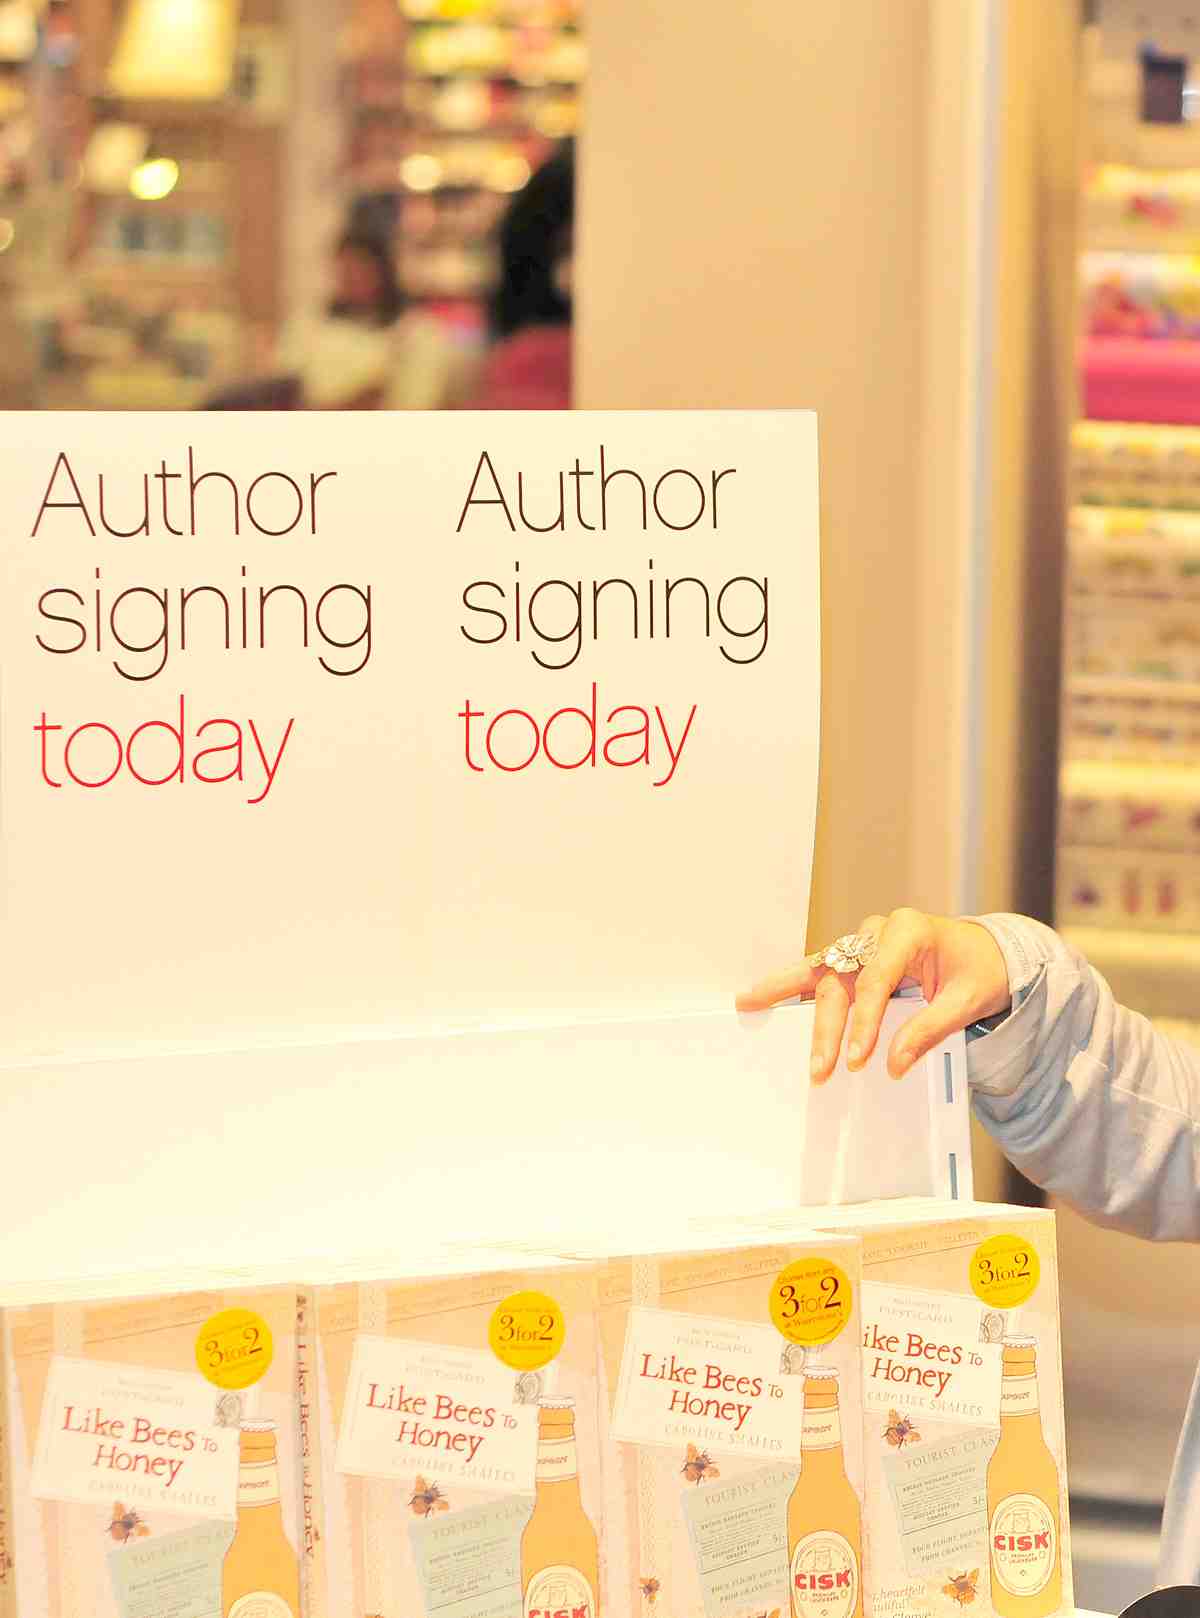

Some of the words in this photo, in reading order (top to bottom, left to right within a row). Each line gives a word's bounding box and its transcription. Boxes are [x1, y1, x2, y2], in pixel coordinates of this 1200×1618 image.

[31, 445, 338, 538] Author
[456, 444, 738, 533] Author
[35, 566, 373, 682] signing
[460, 559, 770, 670] signing
[33, 694, 295, 804] today
[458, 682, 698, 786] today
[863, 1324, 900, 1353] ike
[904, 1333, 963, 1365] Bees
[968, 1351, 984, 1367] To
[640, 1353, 697, 1385] Like
[703, 1364, 763, 1398] Bees
[767, 1383, 784, 1399] To
[871, 1356, 953, 1399] Honey
[61, 1405, 126, 1439] Like
[130, 1416, 196, 1452] Bees
[201, 1437, 218, 1454] To
[366, 1382, 427, 1416] Like
[432, 1394, 497, 1429] Bees
[500, 1414, 518, 1430] To
[668, 1389, 753, 1432] Honey
[395, 1420, 486, 1463] Honey
[92, 1444, 184, 1488] Honey
[994, 1531, 1049, 1551] CISK
[795, 1568, 851, 1590] CISK
